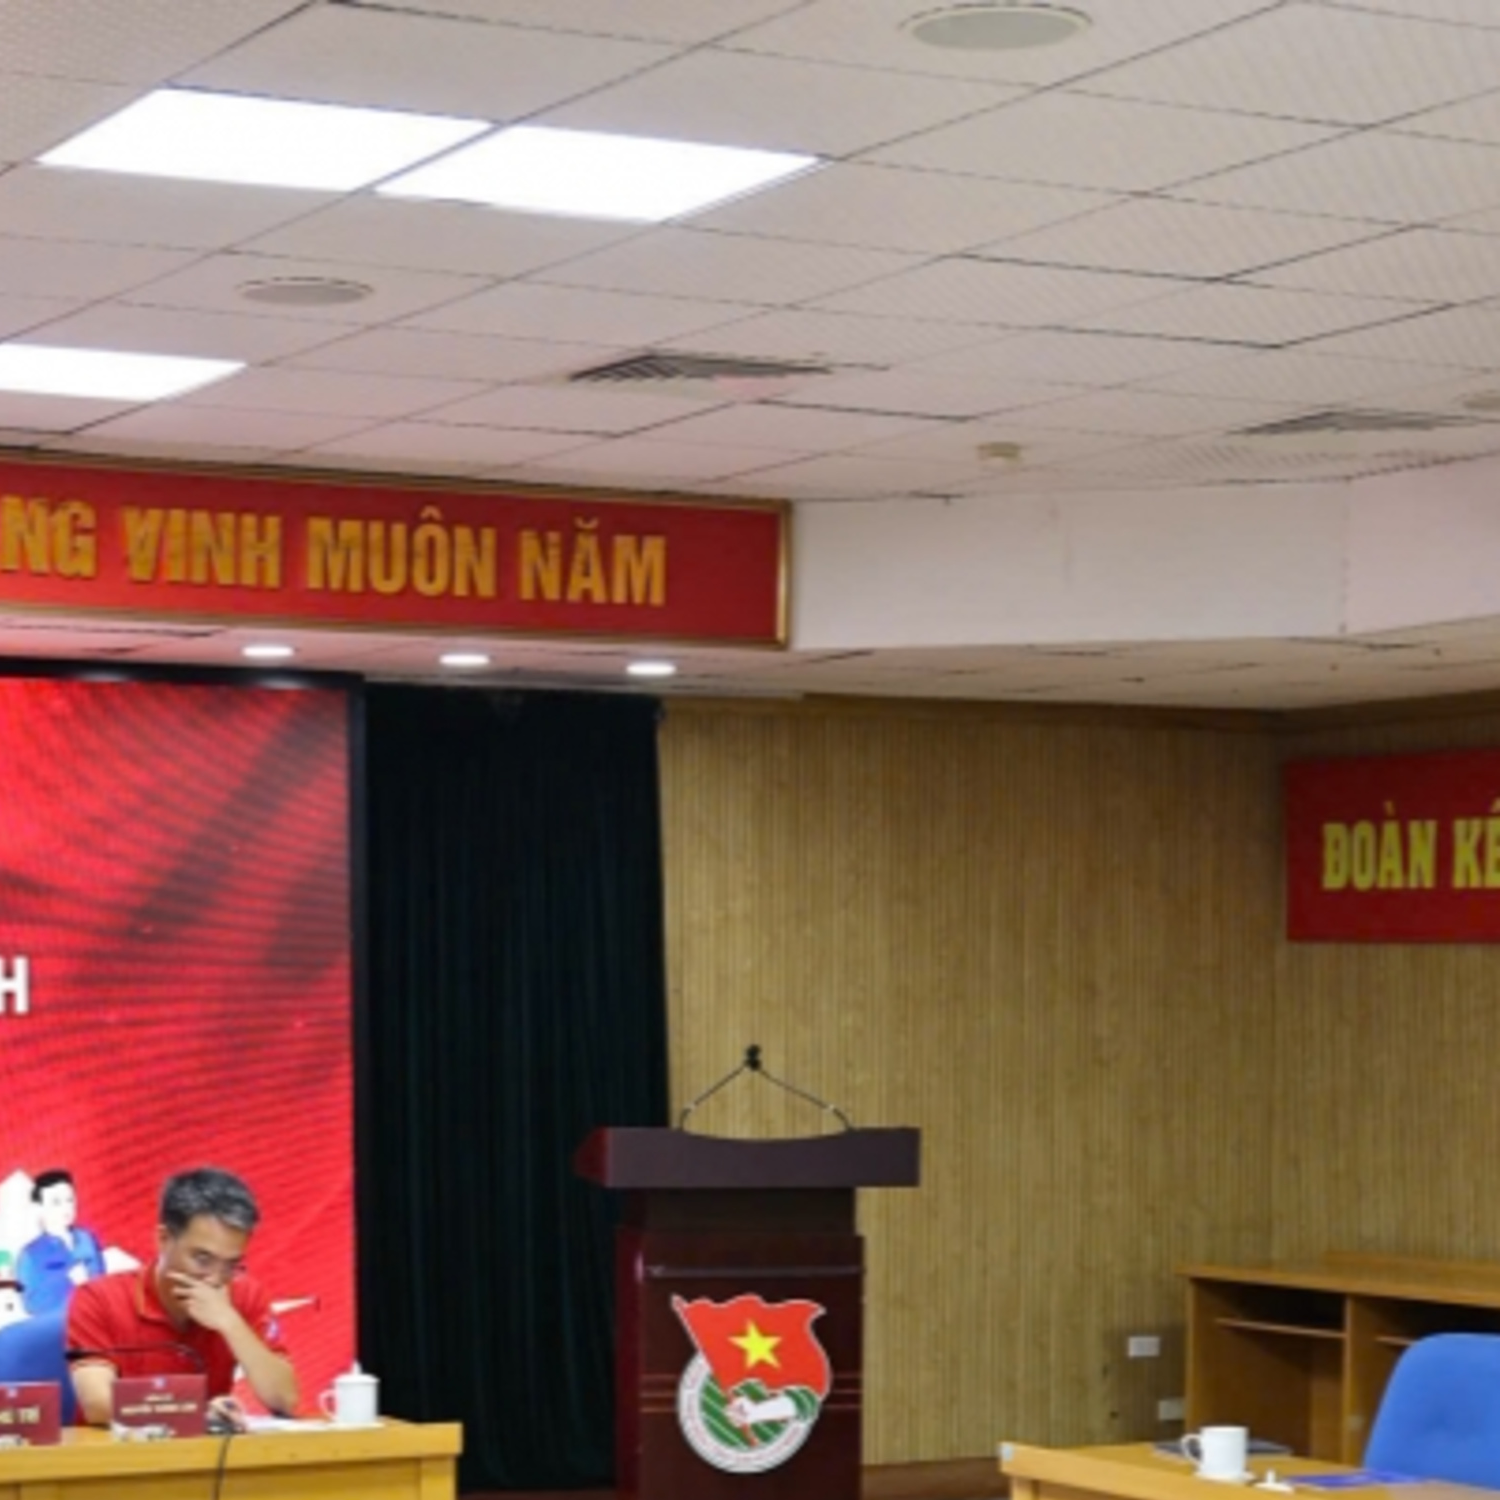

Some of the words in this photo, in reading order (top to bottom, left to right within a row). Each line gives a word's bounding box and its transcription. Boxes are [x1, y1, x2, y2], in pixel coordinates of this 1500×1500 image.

[122, 507, 282, 589] VINH
[306, 505, 497, 598] MUÔN
[518, 517, 666, 606] NĂM
[1322, 799, 1438, 891] ĐOÀN
